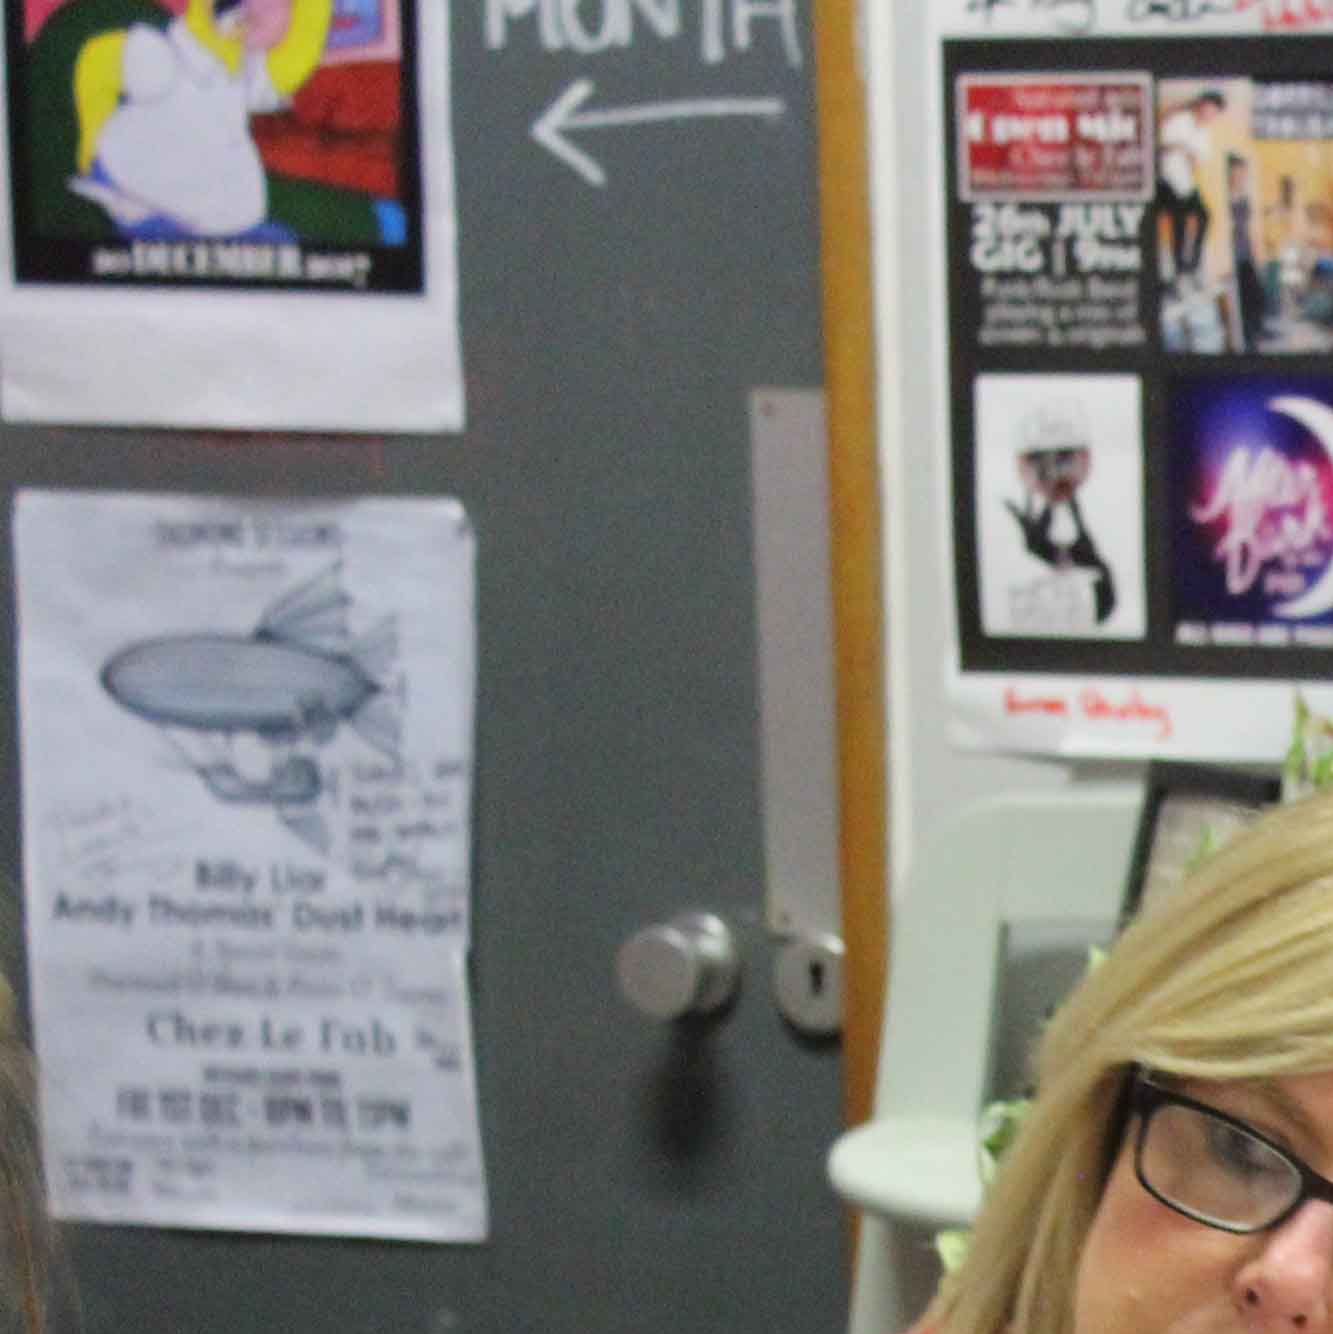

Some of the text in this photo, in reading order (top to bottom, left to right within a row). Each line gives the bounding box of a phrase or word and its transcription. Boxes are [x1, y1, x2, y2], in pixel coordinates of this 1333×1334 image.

[484, 0, 799, 66] MONTH
[1056, 202, 1145, 239] JULY
[971, 240, 1044, 272] GIG
[195, 862, 259, 892] Billy
[52, 892, 134, 928] Andy
[146, 1009, 245, 1046] Chez
